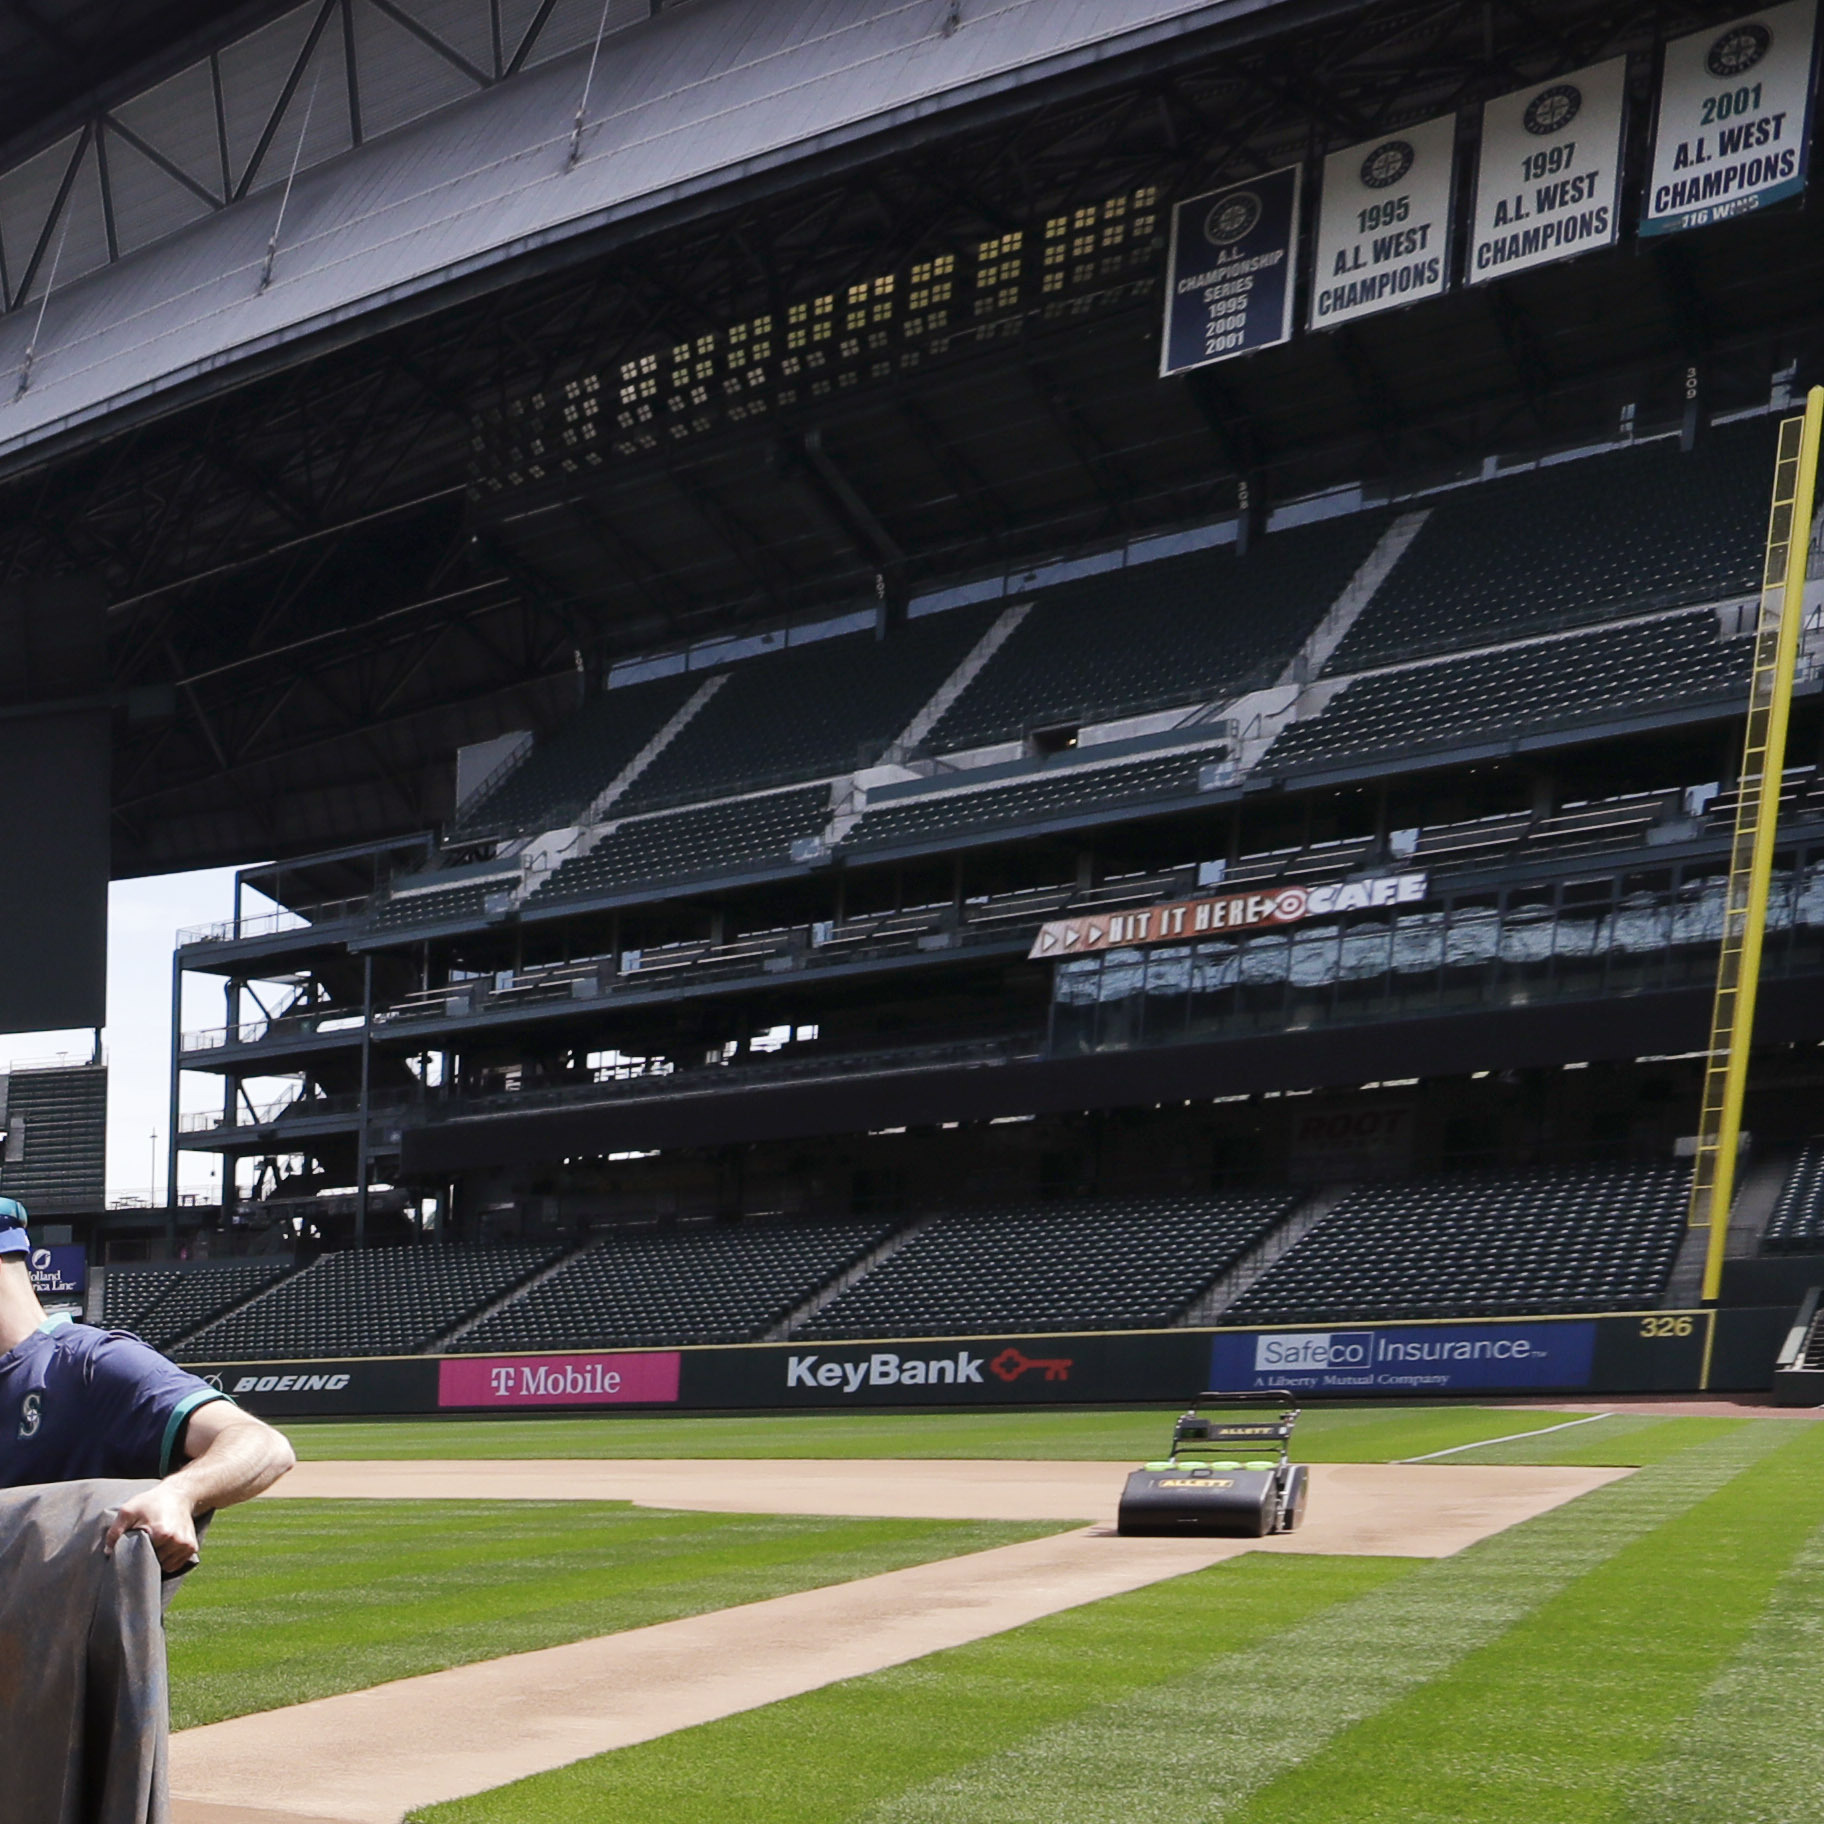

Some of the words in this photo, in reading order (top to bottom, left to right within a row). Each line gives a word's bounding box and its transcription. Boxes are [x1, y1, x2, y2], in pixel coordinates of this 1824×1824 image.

[1700, 82, 1762, 126] 2001
[1521, 142, 1576, 182] 1997
[1673, 137, 1712, 172] A.L.
[1718, 112, 1787, 157] WEST
[1493, 194, 1530, 229] A.L.
[1536, 170, 1599, 215] WEST
[1654, 148, 1795, 214] CHAMPIONS
[1357, 195, 1410, 234] 1995
[1372, 223, 1431, 265] WEST
[1477, 206, 1608, 270] CHAMPIONS
[1177, 248, 1284, 295] CHAMPIONSHIP
[1204, 275, 1254, 303] SERIES
[1318, 257, 1440, 317] CHAMPIONS
[1205, 312, 1246, 339] 2000
[1208, 294, 1248, 319] 1995
[1205, 330, 1245, 356] 2001
[1686, 367, 1697, 399] 309
[1109, 912, 1150, 943] HIT
[1160, 906, 1186, 936] IT
[1195, 897, 1261, 932] HERE
[1307, 872, 1426, 915] CAFE
[1640, 1317, 1693, 1337] 326
[1264, 1340, 1364, 1364] Safeco
[1377, 1337, 1529, 1362] Insurance
[233, 1374, 351, 1392] BOEING
[519, 1364, 620, 1395] Mobile
[787, 1352, 984, 1392] KeyBank
[1254, 1376, 1264, 1386] A
[1267, 1376, 1318, 1387] Liberty
[1323, 1374, 1374, 1385] Mutual
[1377, 1373, 1450, 1387] Company
[18, 1393, 42, 1438] S
